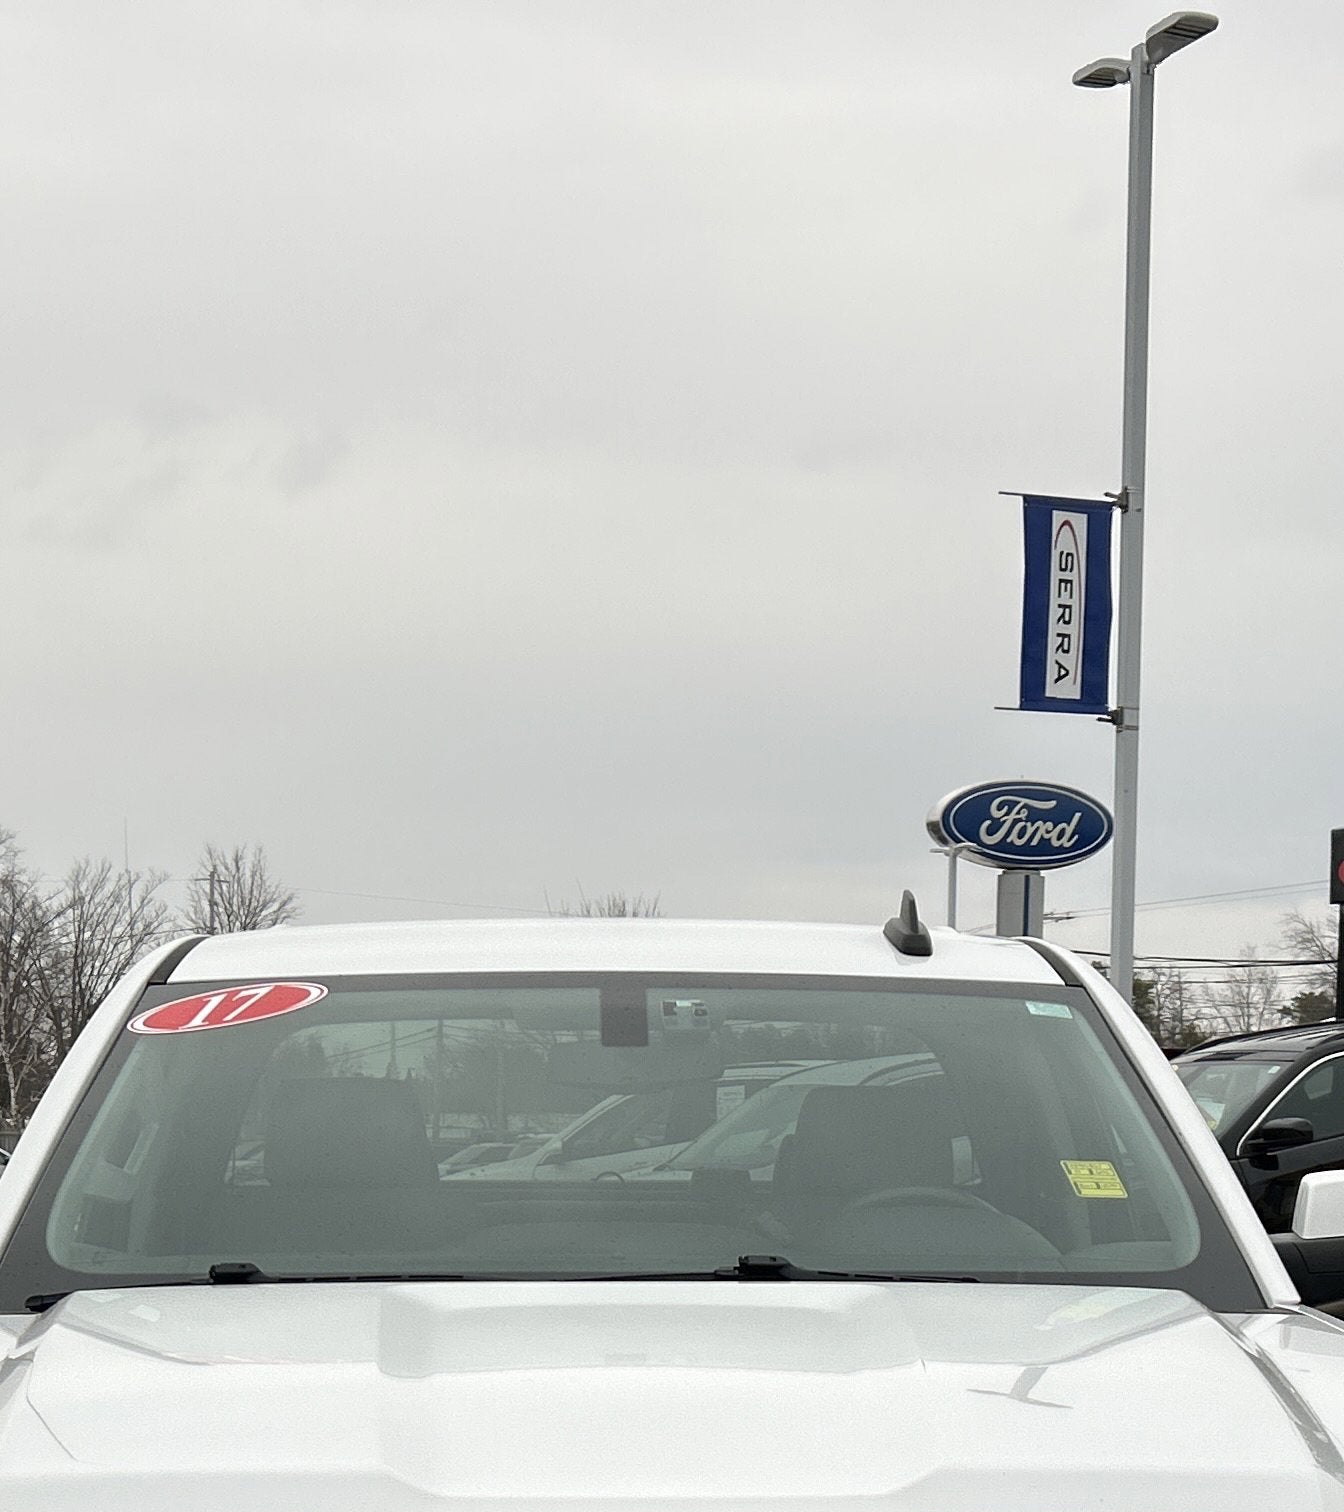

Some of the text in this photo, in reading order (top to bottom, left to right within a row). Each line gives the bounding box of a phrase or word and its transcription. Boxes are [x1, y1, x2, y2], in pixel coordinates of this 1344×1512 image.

[1053, 550, 1074, 684] SERRA
[979, 795, 1082, 847] Ford
[178, 984, 276, 1030] 17
